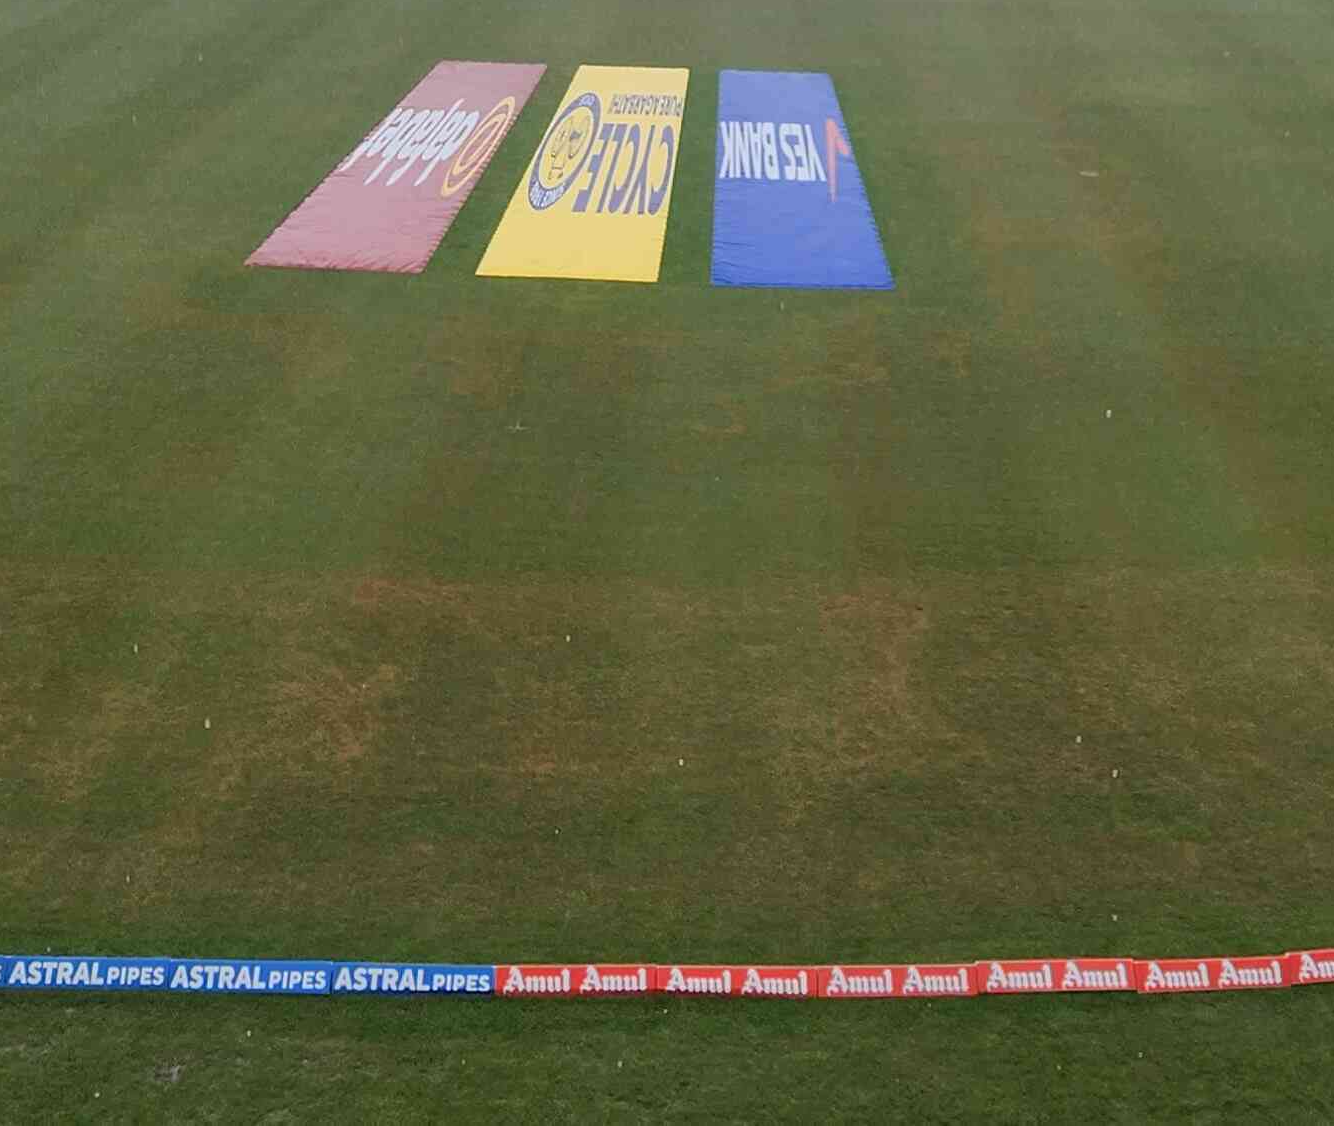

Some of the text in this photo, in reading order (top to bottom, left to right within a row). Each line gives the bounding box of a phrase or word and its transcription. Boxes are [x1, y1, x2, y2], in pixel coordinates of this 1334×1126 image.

[338, 97, 480, 187] dafabet
[719, 121, 827, 182] YES BANK
[571, 123, 675, 216] CYCLE
[9, 961, 165, 987] ASTRAL PIPES
[170, 964, 327, 991] ASTRAL PIPES
[334, 967, 491, 993] ASTRAL PIPES
[503, 966, 571, 995] Amul
[579, 964, 647, 995] Amul
[667, 967, 732, 996] Amul
[741, 968, 809, 997] Amul
[826, 965, 893, 996] Amul
[901, 965, 968, 995] Amul
[986, 961, 1053, 992] Amul
[1061, 959, 1128, 991] Amul
[1145, 960, 1210, 991] Amul
[1218, 958, 1283, 989] Amul
